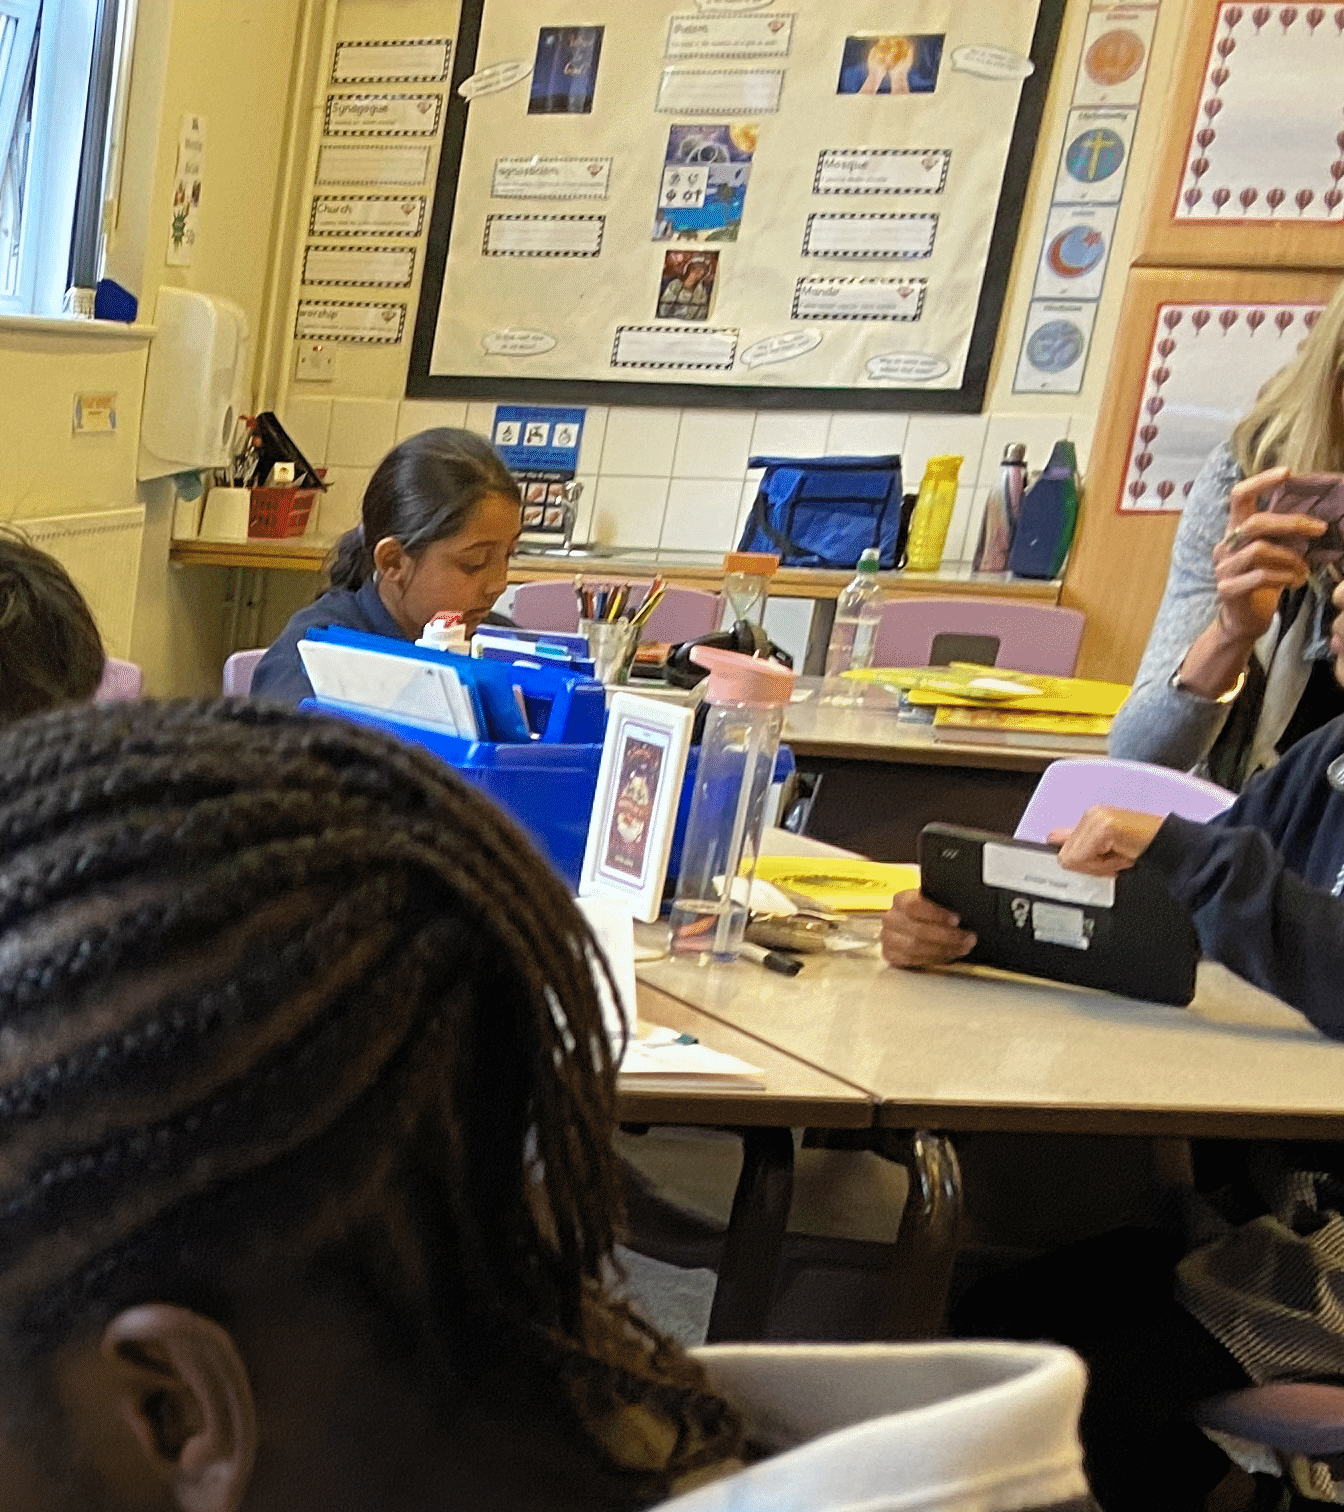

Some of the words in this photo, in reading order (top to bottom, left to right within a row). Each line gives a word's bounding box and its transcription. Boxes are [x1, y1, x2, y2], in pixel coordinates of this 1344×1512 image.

[332, 102, 388, 117] Synagogue
[825, 158, 869, 173] Mosque
[317, 203, 353, 215] Church
[299, 308, 339, 321] worship
